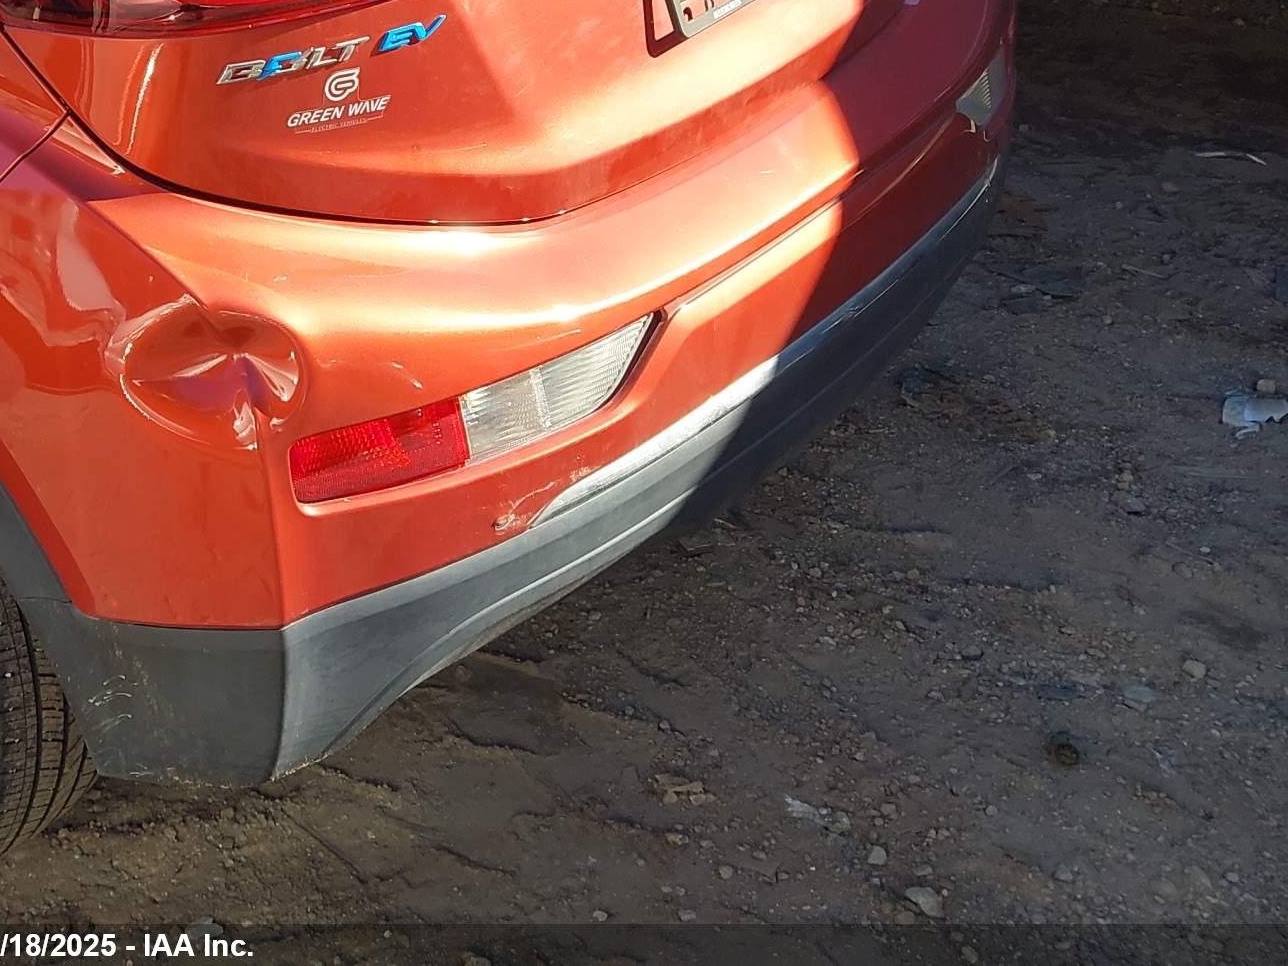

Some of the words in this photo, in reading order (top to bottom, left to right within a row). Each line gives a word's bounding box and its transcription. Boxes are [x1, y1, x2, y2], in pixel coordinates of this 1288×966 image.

[216, 35, 371, 84] BOLT
[379, 14, 447, 52] EV
[287, 105, 346, 128] GREEN
[348, 95, 392, 117] WAVE
